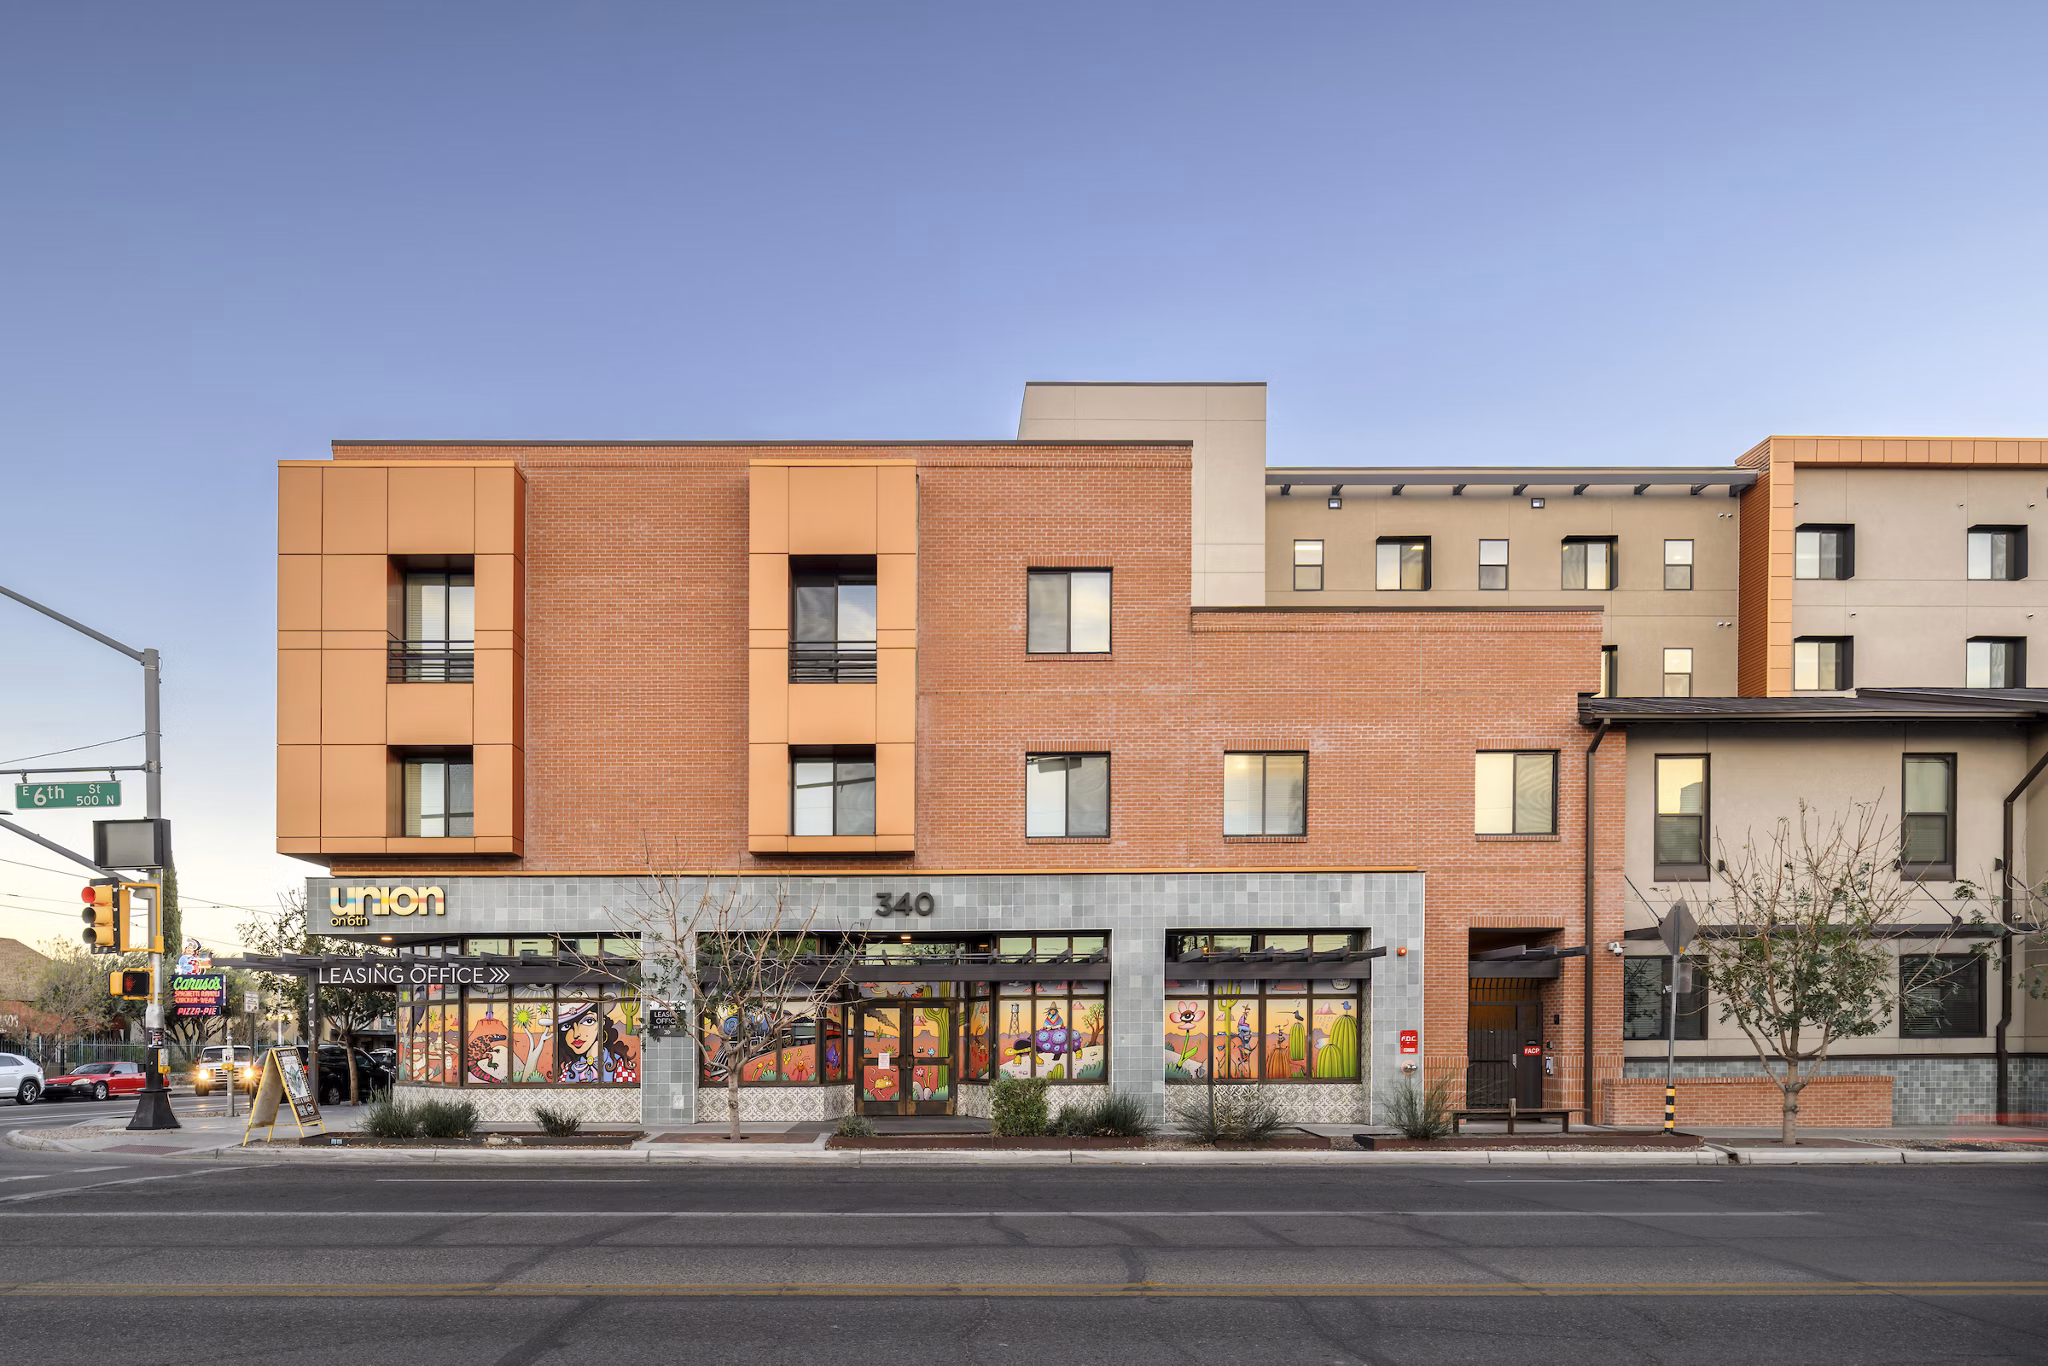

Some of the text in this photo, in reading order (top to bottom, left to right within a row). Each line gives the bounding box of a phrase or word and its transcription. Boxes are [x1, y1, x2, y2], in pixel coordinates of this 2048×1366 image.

[22, 784, 101, 806] E 6th St
[76, 795, 114, 806] 500 N
[330, 886, 445, 916] union
[875, 892, 935, 917] 340
[173, 976, 222, 991] Caruso's
[319, 967, 484, 984] LEASING OFFICE
[177, 1007, 218, 1015] PIZZA-PIE
